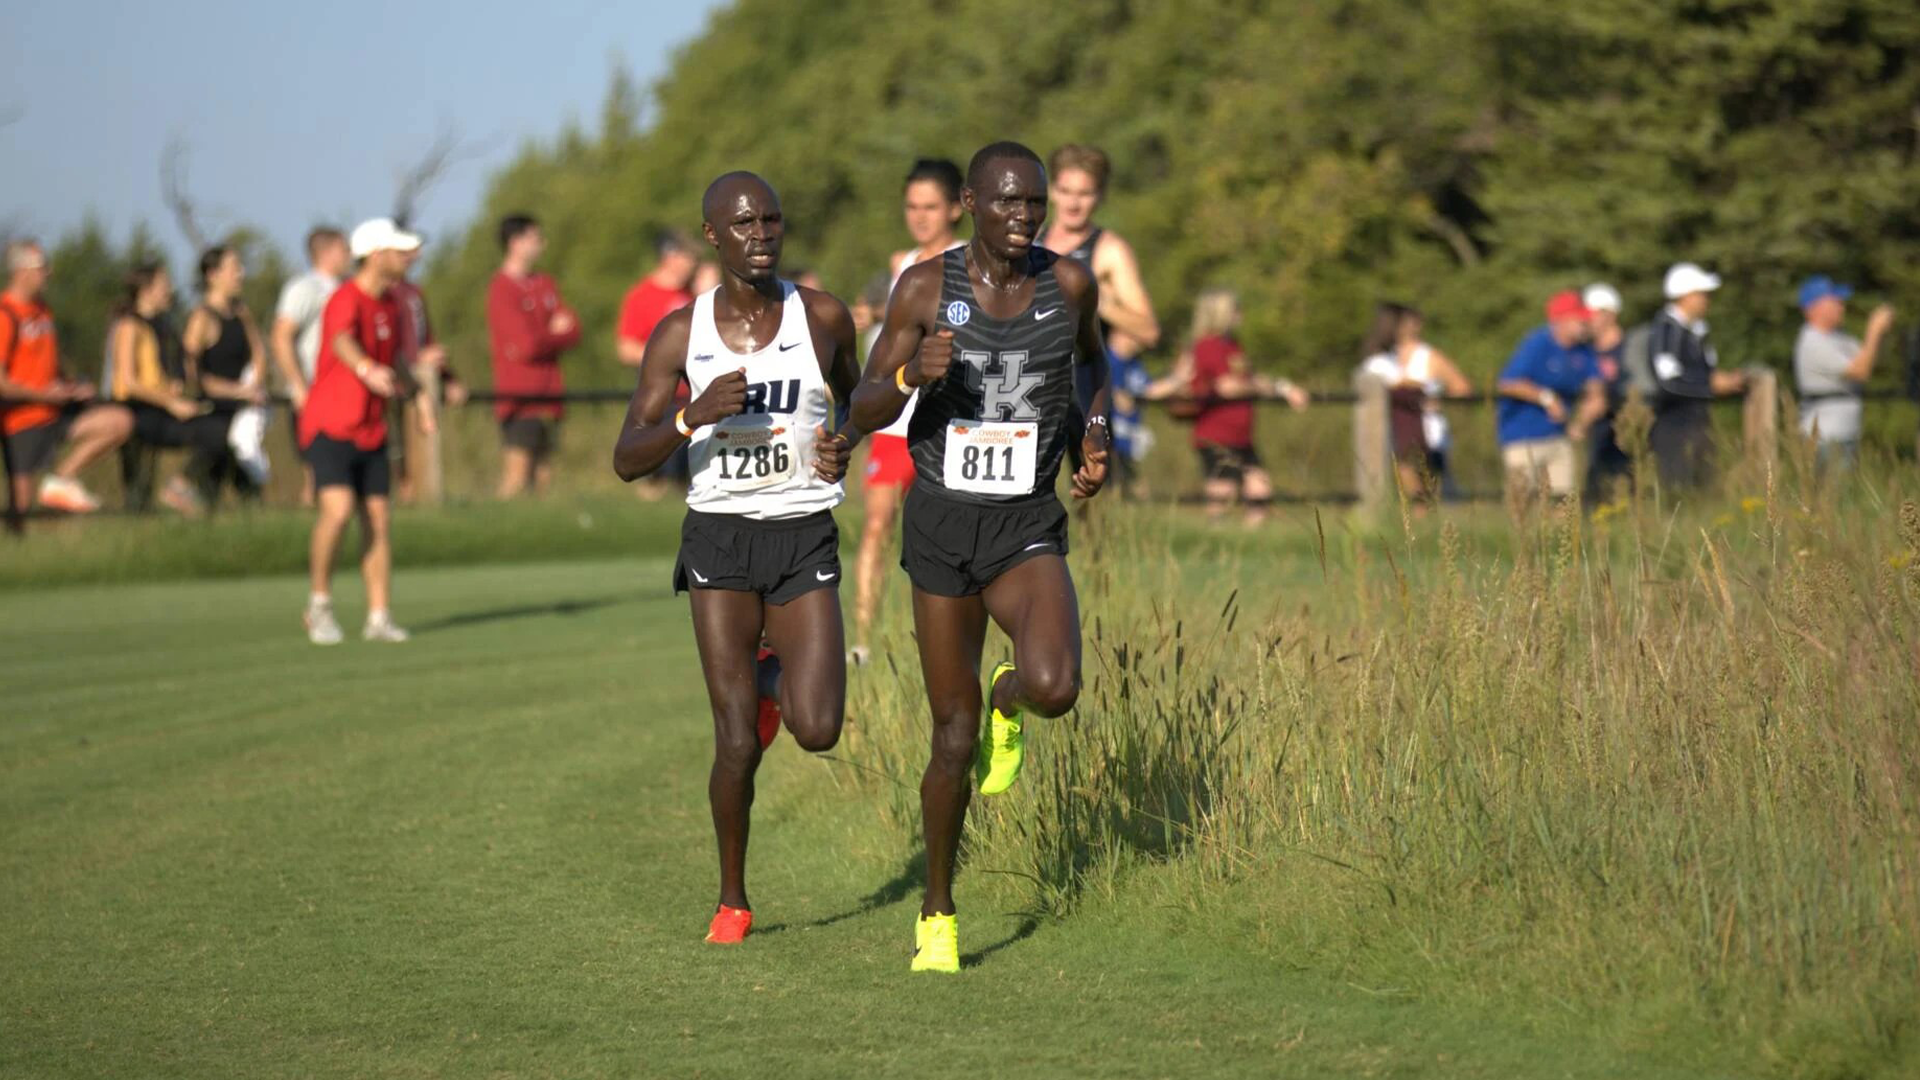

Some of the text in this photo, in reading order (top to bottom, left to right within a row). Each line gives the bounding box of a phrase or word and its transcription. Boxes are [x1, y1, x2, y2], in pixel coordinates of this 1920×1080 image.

[949, 303, 969, 323] SEC
[742, 379, 801, 414] RU
[961, 350, 1046, 421] UK
[971, 429, 1011, 437] COWBOY
[717, 442, 789, 479] 1286
[961, 445, 1015, 481] 811
